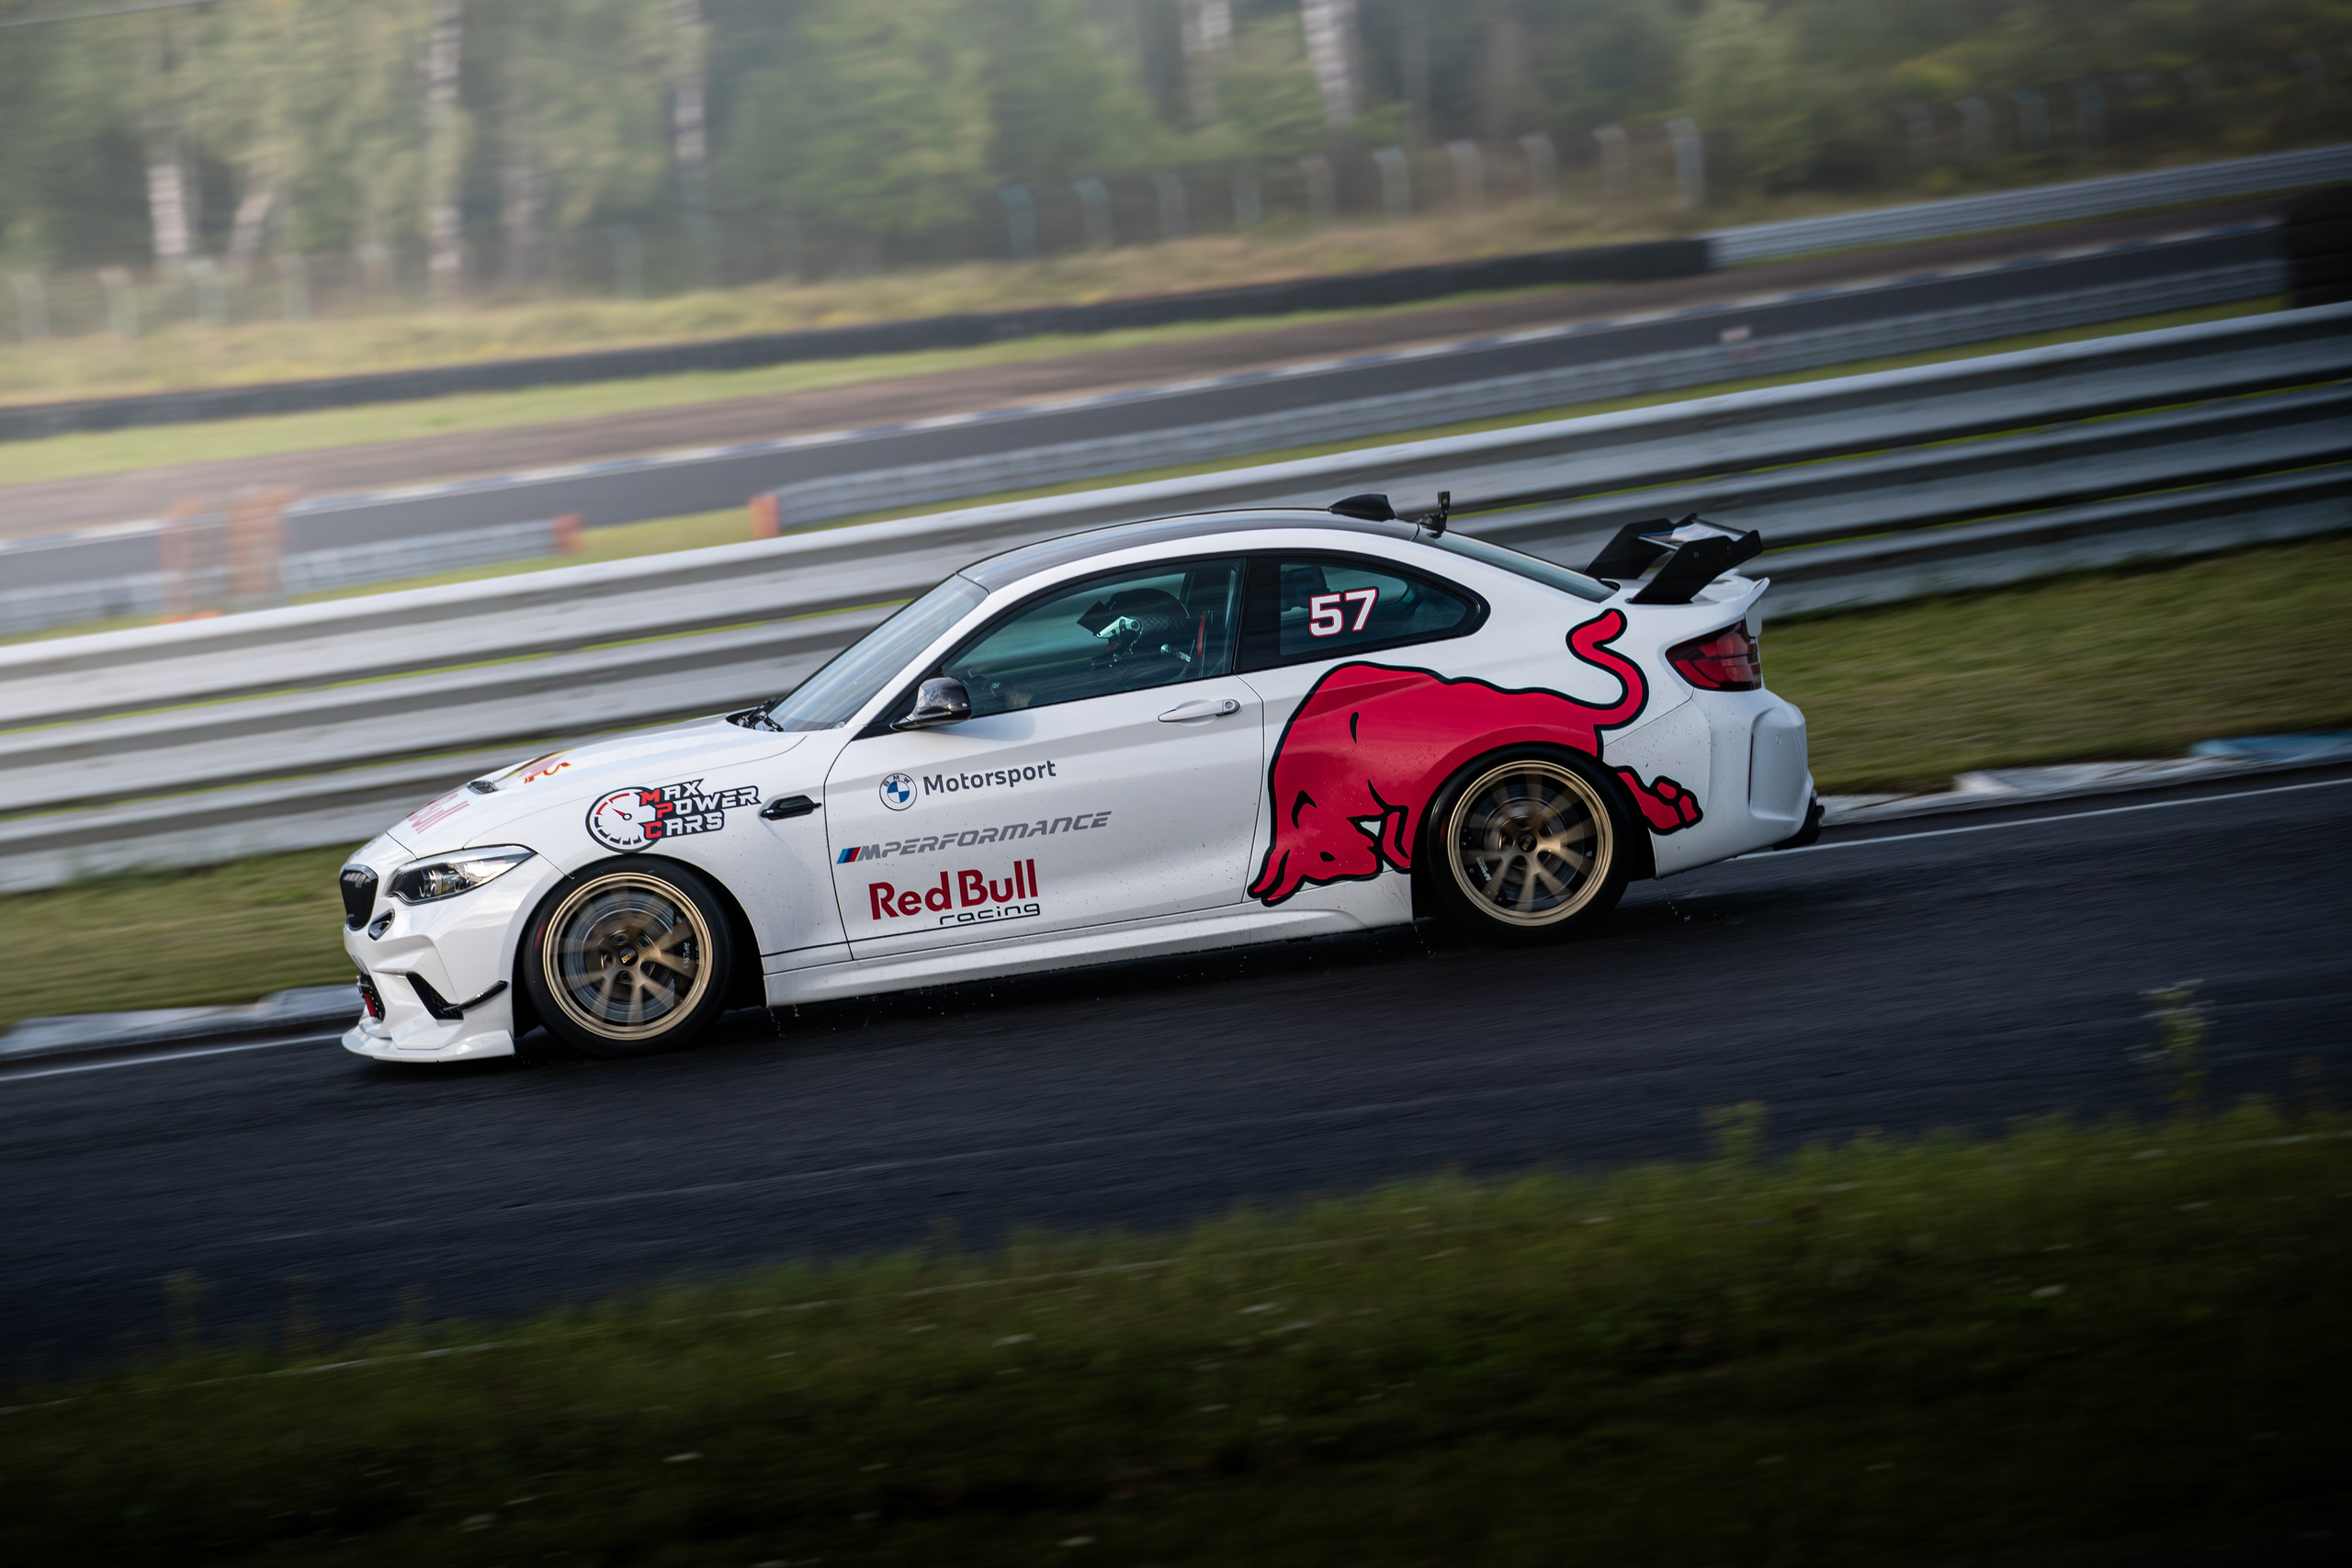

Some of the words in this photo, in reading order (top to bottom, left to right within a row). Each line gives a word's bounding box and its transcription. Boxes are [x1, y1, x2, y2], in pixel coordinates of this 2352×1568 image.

[1309, 587, 1378, 637] 57
[639, 779, 704, 806] MAX
[922, 761, 1057, 795] Motorsport
[654, 786, 759, 818] POWER
[642, 811, 722, 839] CARS
[868, 871, 952, 920] Red
[957, 859, 1038, 908] Bull
[939, 903, 1041, 925] racing
